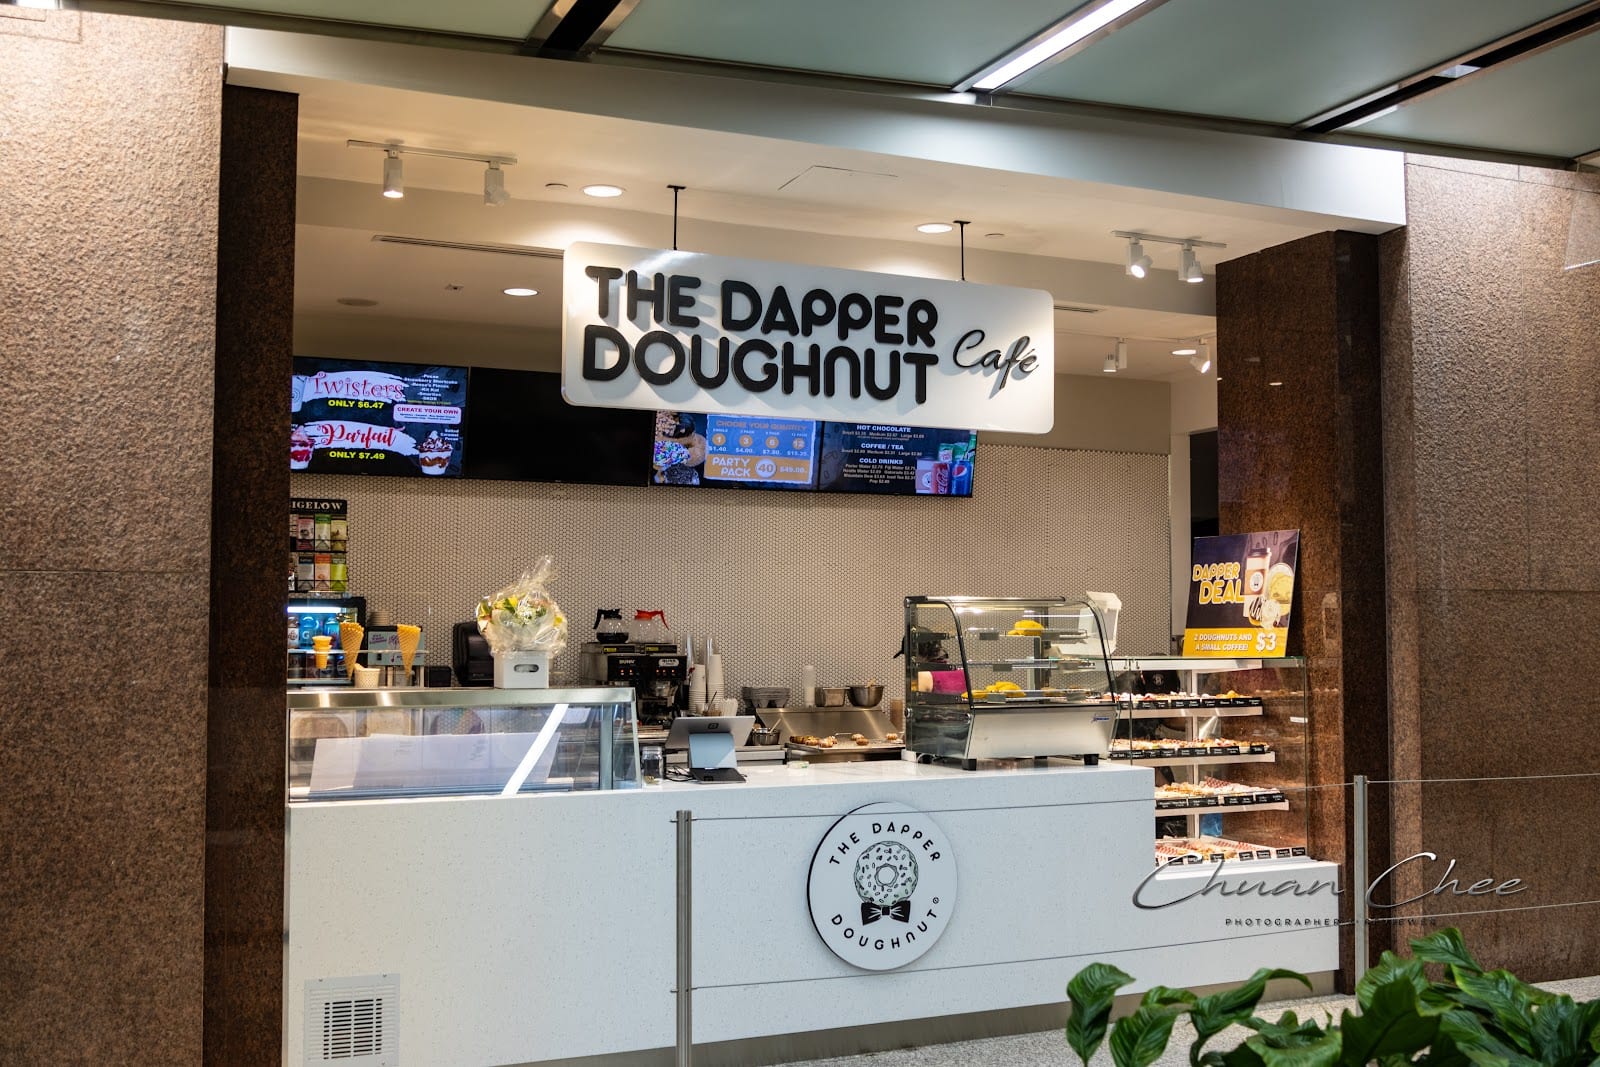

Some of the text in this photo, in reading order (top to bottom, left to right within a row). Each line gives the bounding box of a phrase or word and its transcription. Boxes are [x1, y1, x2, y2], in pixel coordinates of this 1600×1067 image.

[585, 265, 938, 348] THE DAPPER
[582, 324, 939, 405] DOUGHNUT
[953, 329, 1039, 390] Café
[308, 371, 403, 399] Twisters
[328, 400, 384, 409] ONLY $6.47
[317, 424, 405, 449] Parfait
[329, 450, 385, 460] ONLY $7.49
[712, 458, 750, 467] PARTY
[721, 467, 750, 477] PACK
[758, 464, 774, 472] 40
[292, 501, 342, 510] IGELOW
[1192, 562, 1241, 582] DAPPER
[1199, 579, 1245, 604] DEAL
[1256, 632, 1276, 652] $3
[830, 822, 941, 866] THE DAPPER
[831, 909, 937, 950] DOUGHNUT
